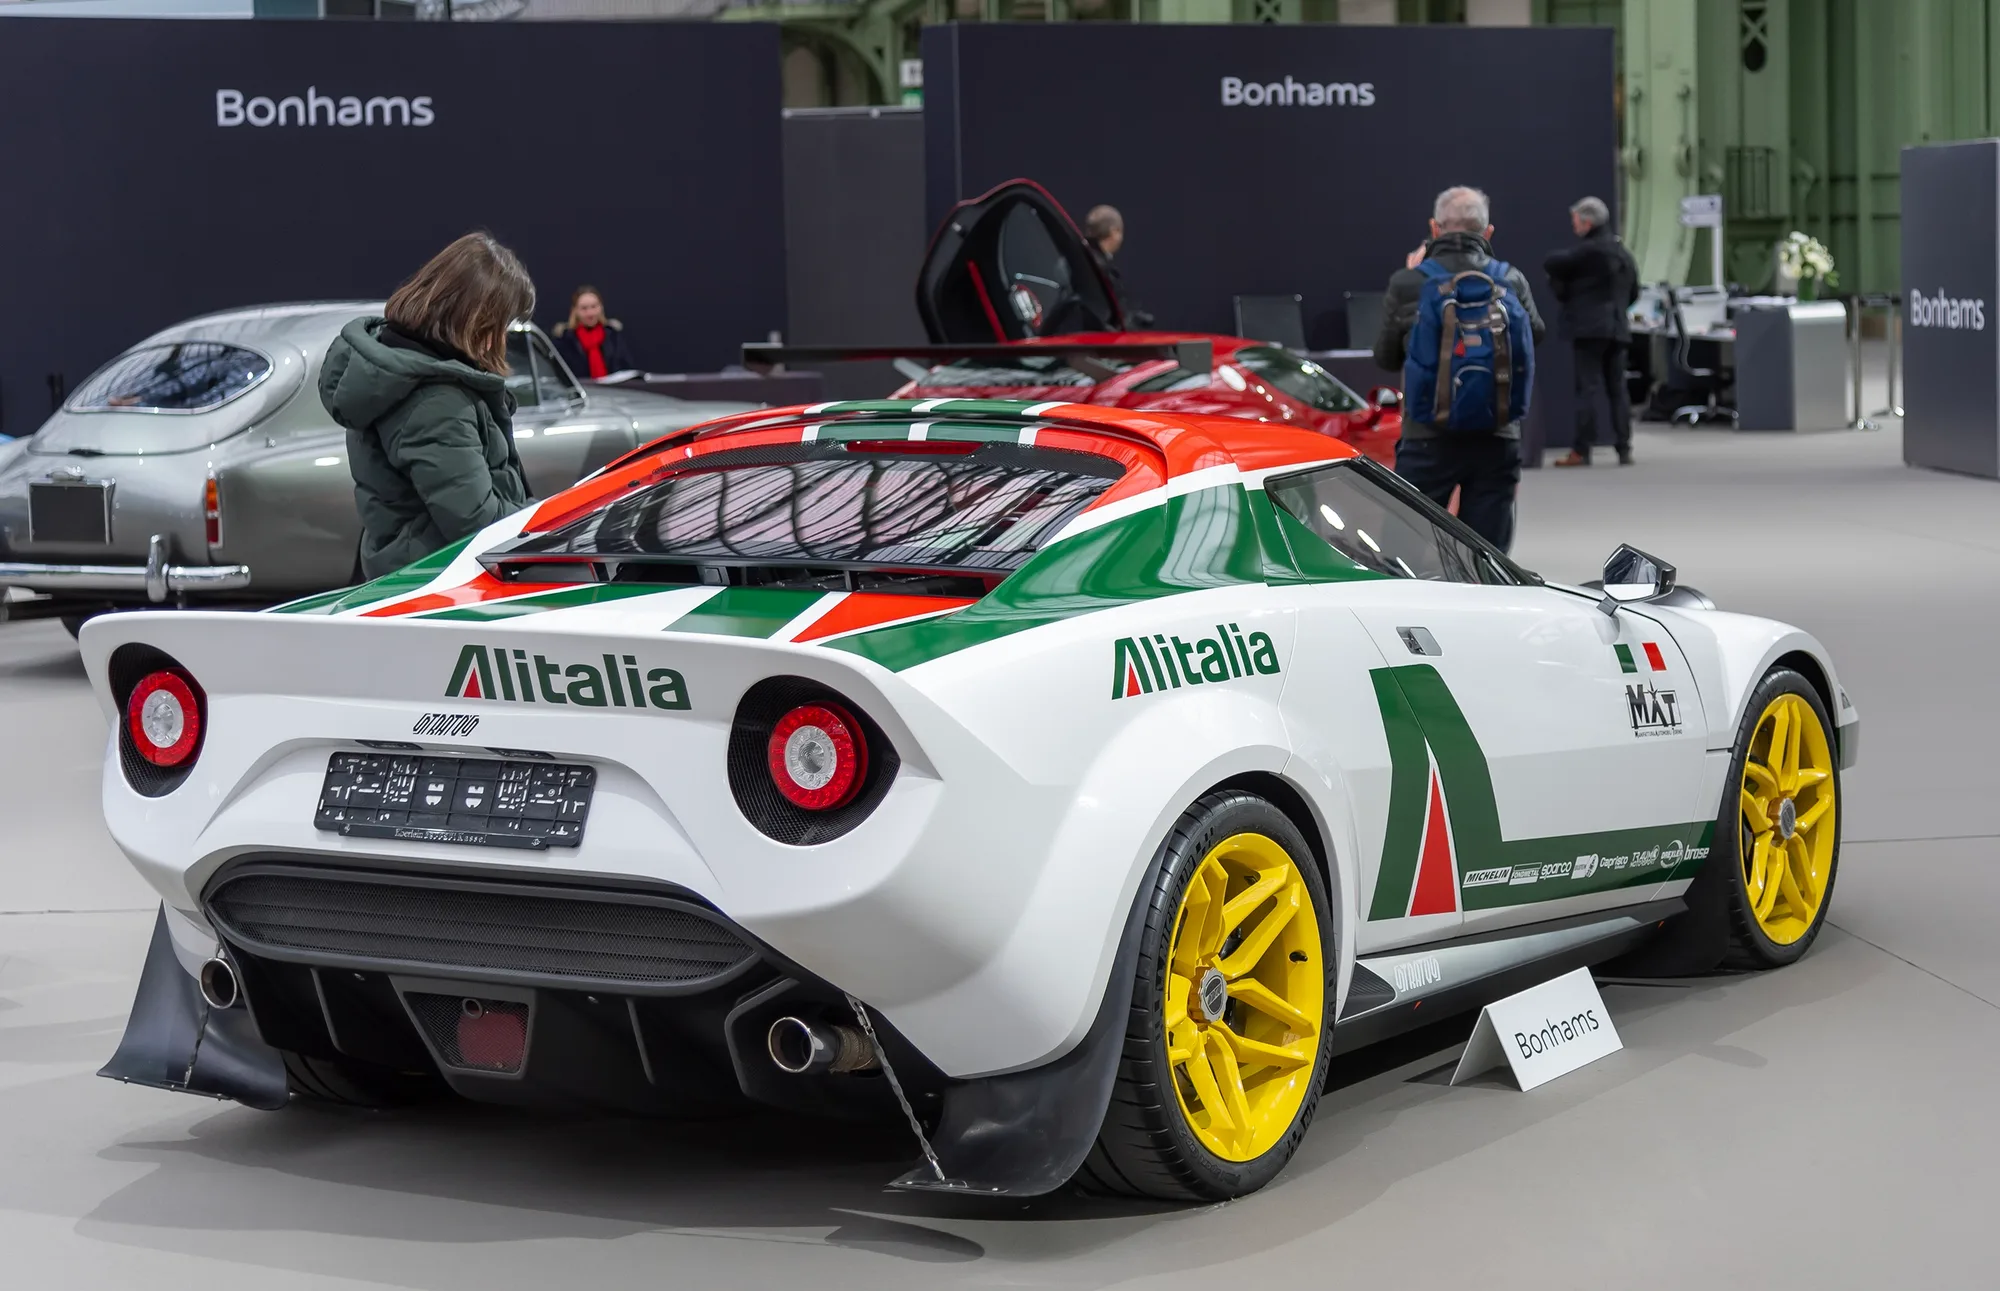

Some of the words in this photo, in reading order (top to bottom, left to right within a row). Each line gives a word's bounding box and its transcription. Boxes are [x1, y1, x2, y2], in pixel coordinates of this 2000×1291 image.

[215, 85, 435, 127] Bonhams
[1220, 74, 1376, 107] Bonhams
[1910, 286, 1985, 331] Bonhams
[444, 644, 693, 710] Alitalia
[1112, 622, 1281, 700] Alitalia
[1625, 680, 1676, 730] MAT
[412, 713, 480, 737] STRATOS
[1541, 861, 1573, 880] sparco
[1600, 855, 1629, 869] Capristo
[1684, 845, 1710, 861] brose
[1466, 868, 1511, 883] MICHELIN
[1394, 956, 1441, 993] STRATOS
[1514, 1008, 1600, 1060] Bonhams
